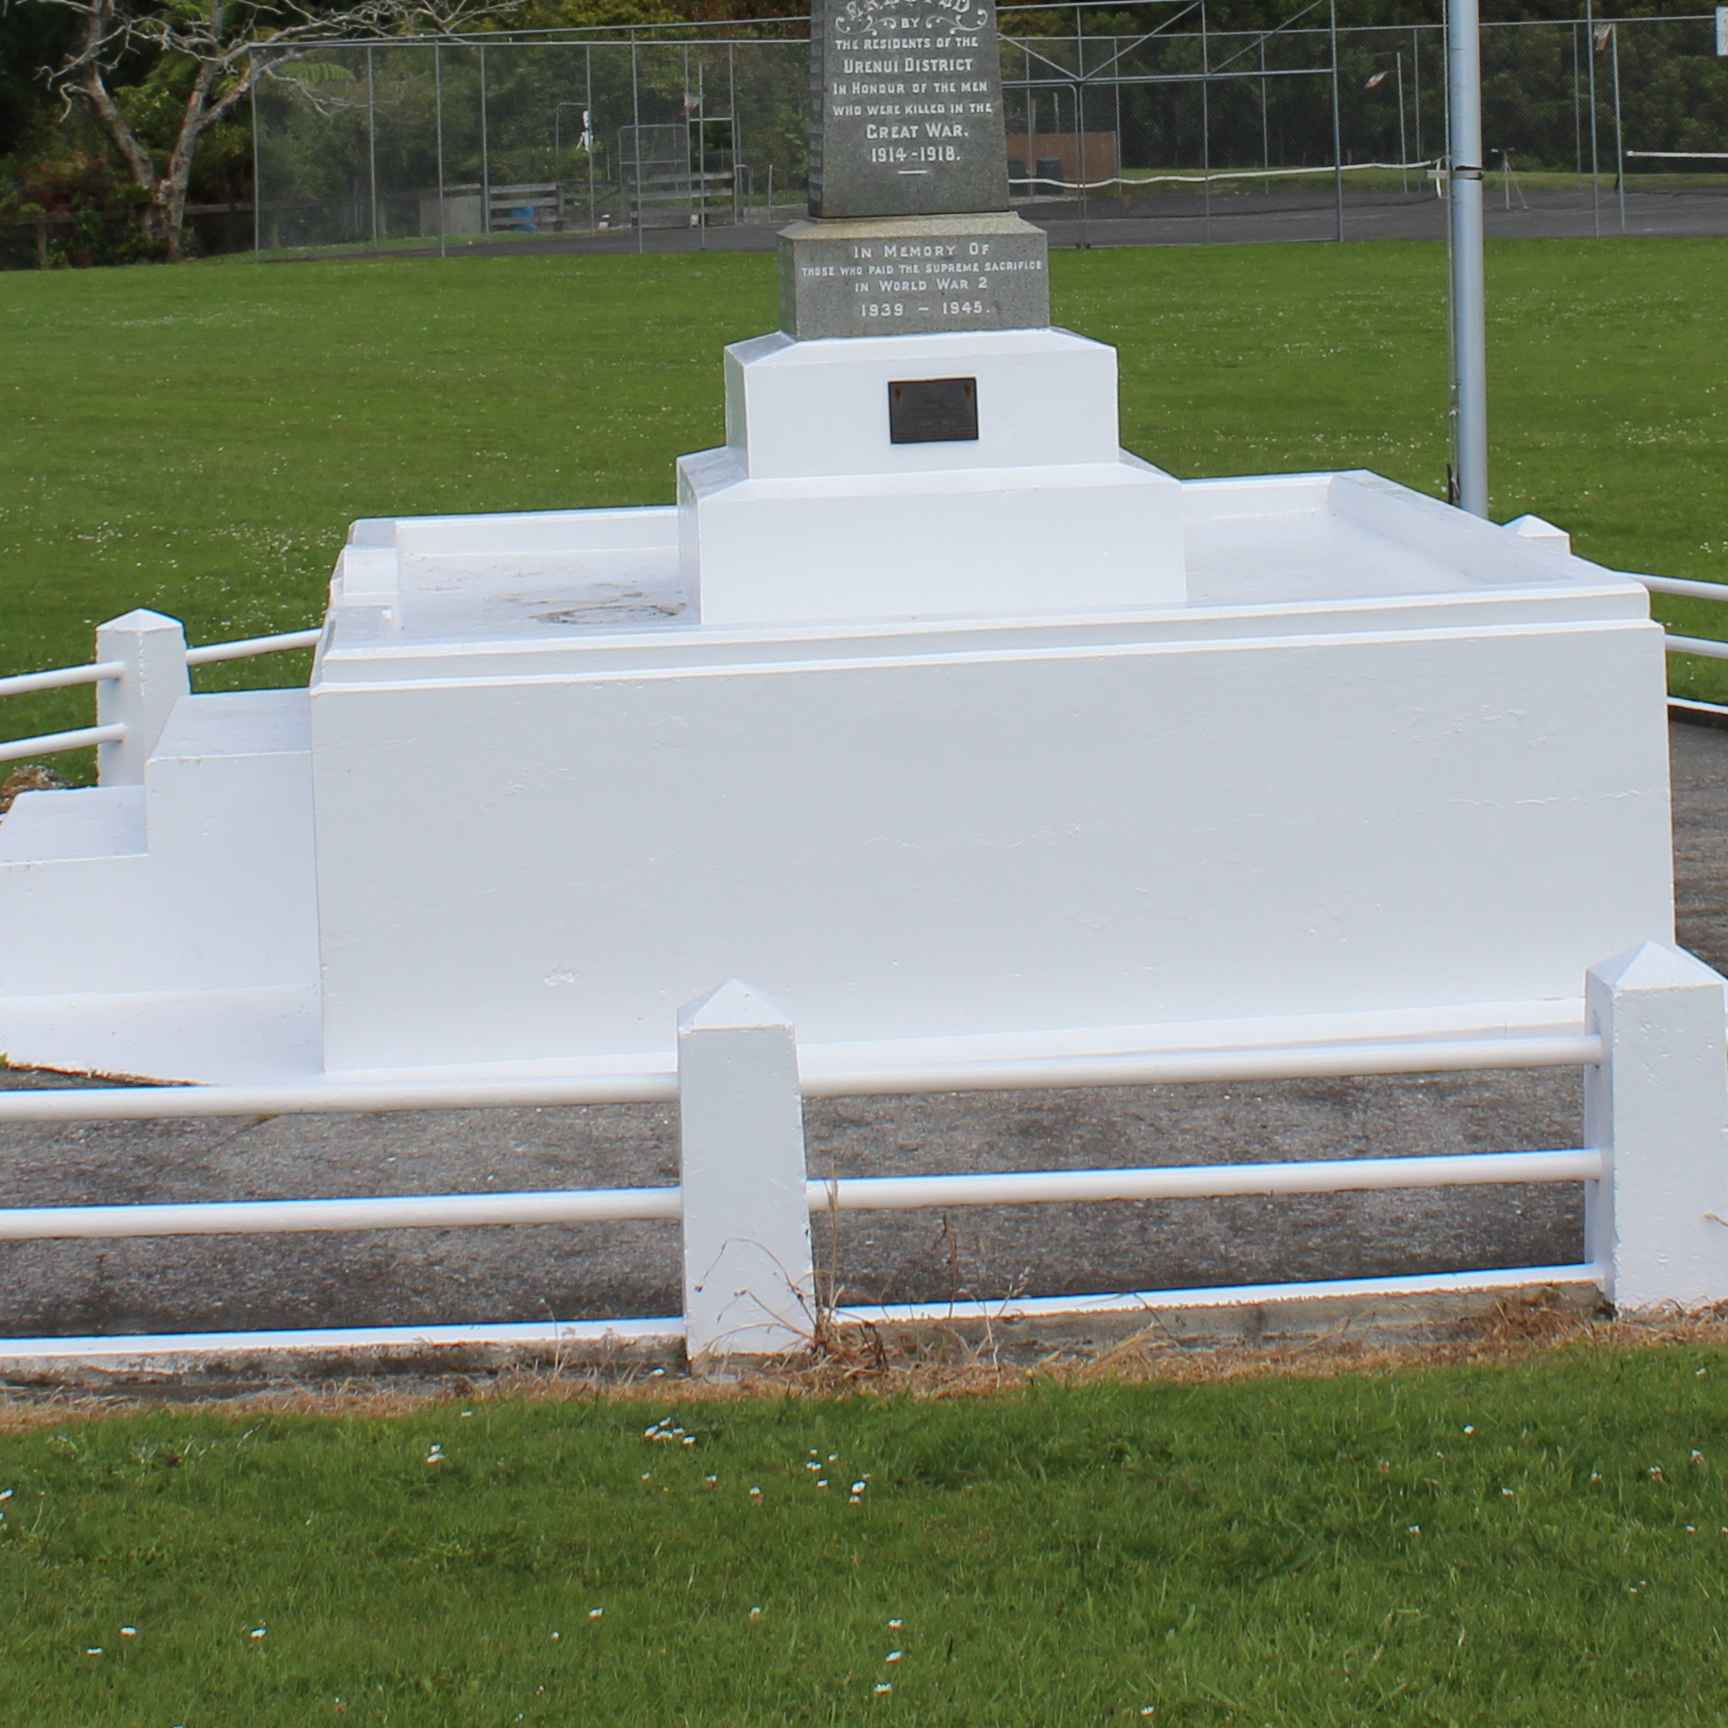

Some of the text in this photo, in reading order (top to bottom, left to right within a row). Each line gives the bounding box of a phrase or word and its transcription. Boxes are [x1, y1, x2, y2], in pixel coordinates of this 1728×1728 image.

[900, 17, 921, 29] BY
[835, 36, 979, 50] THE RESIDENTS OF THE
[843, 57, 973, 74] URENUI DISTRICT
[833, 81, 988, 95] IN HONOUR OF THE MEN
[832, 102, 993, 116] WHO WERE KILLED IN THE
[866, 122, 969, 139] GREAT WAR.
[854, 242, 990, 259] IN MEMORY OF
[801, 261, 1043, 277] THOSE WHO PAID THE SUPREME SACRIFICE
[855, 277, 988, 293] IN WORLD WAR 2
[861, 303, 904, 317] 1939
[942, 301, 991, 314] 1945.
